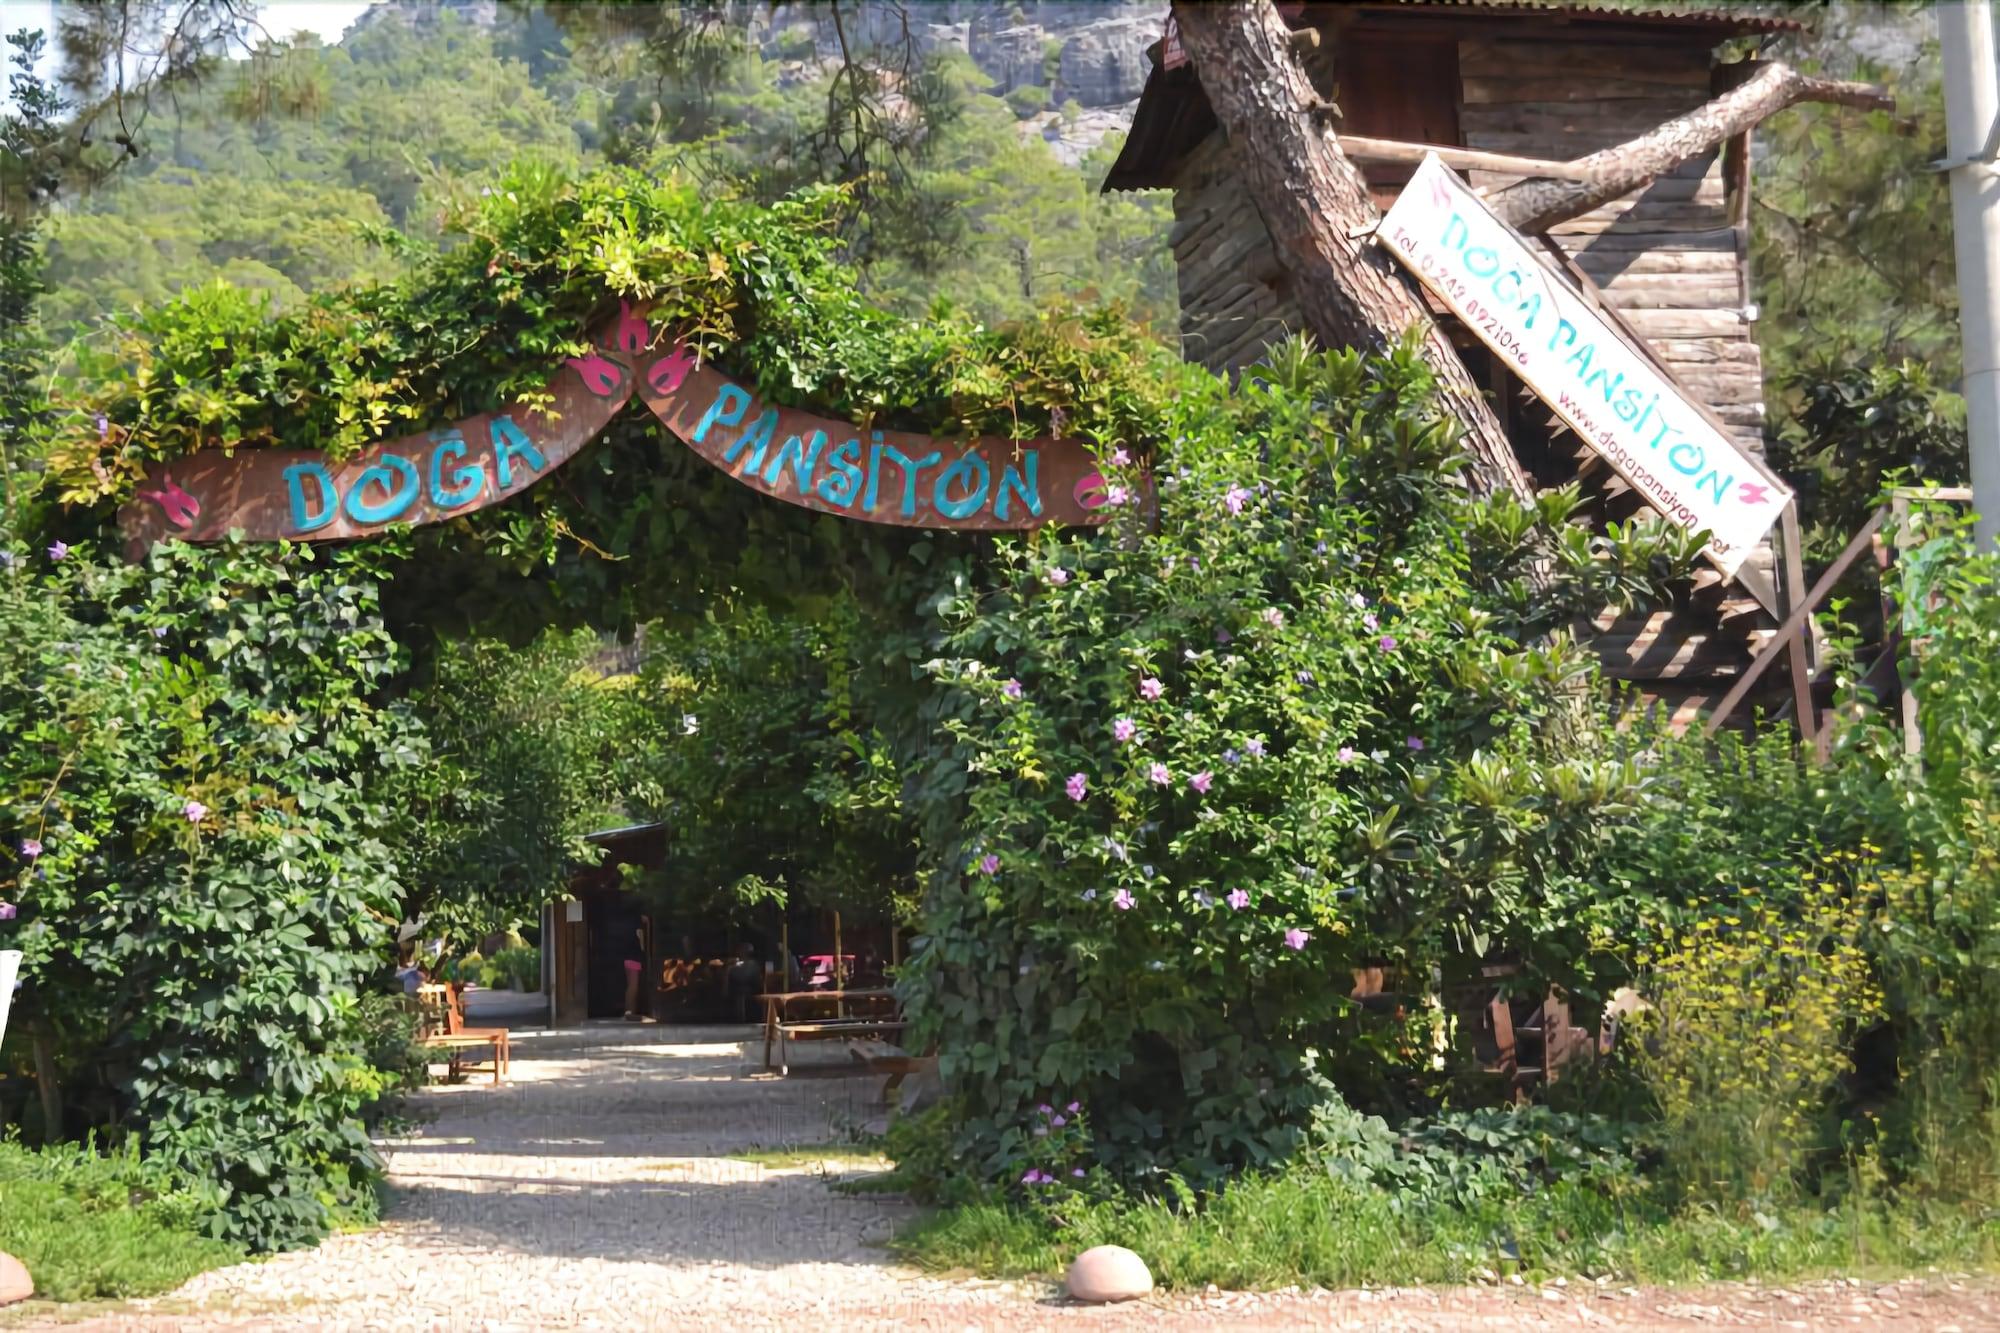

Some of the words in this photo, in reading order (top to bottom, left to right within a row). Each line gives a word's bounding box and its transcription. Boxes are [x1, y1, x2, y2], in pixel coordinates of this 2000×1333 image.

[283, 414, 545, 531] DOĞA
[693, 383, 1043, 521] PANSİYON
[1440, 213, 1541, 329] DOĞA
[1548, 317, 1734, 505] PANSİYON
